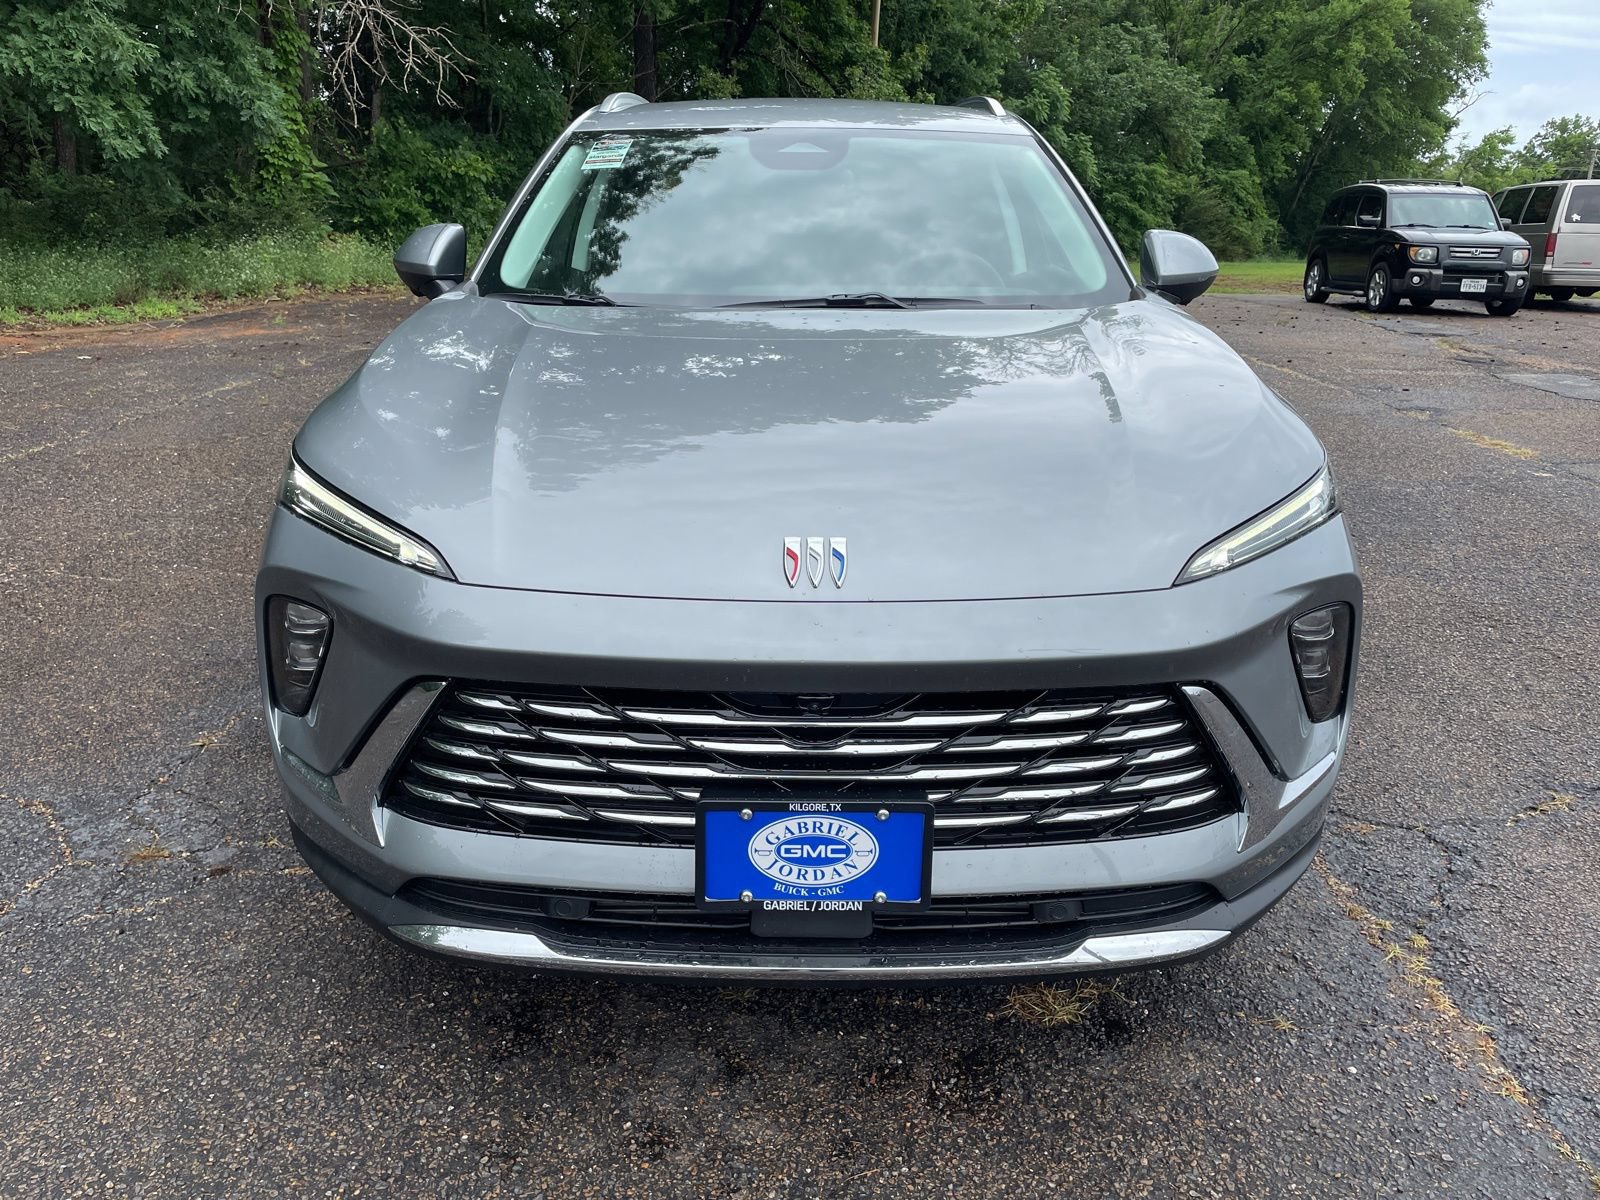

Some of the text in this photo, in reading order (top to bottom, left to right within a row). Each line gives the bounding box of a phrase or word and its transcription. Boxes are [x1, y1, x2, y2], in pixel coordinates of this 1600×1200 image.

[789, 803, 842, 812] KILGORE, TX
[765, 820, 859, 846] GABRIEL
[780, 844, 847, 858] GMC
[765, 859, 859, 882] JORDAN
[773, 882, 809, 896] BUICK
[817, 885, 845, 896] GMC
[763, 901, 863, 911] GABRIEL / JORDAN
